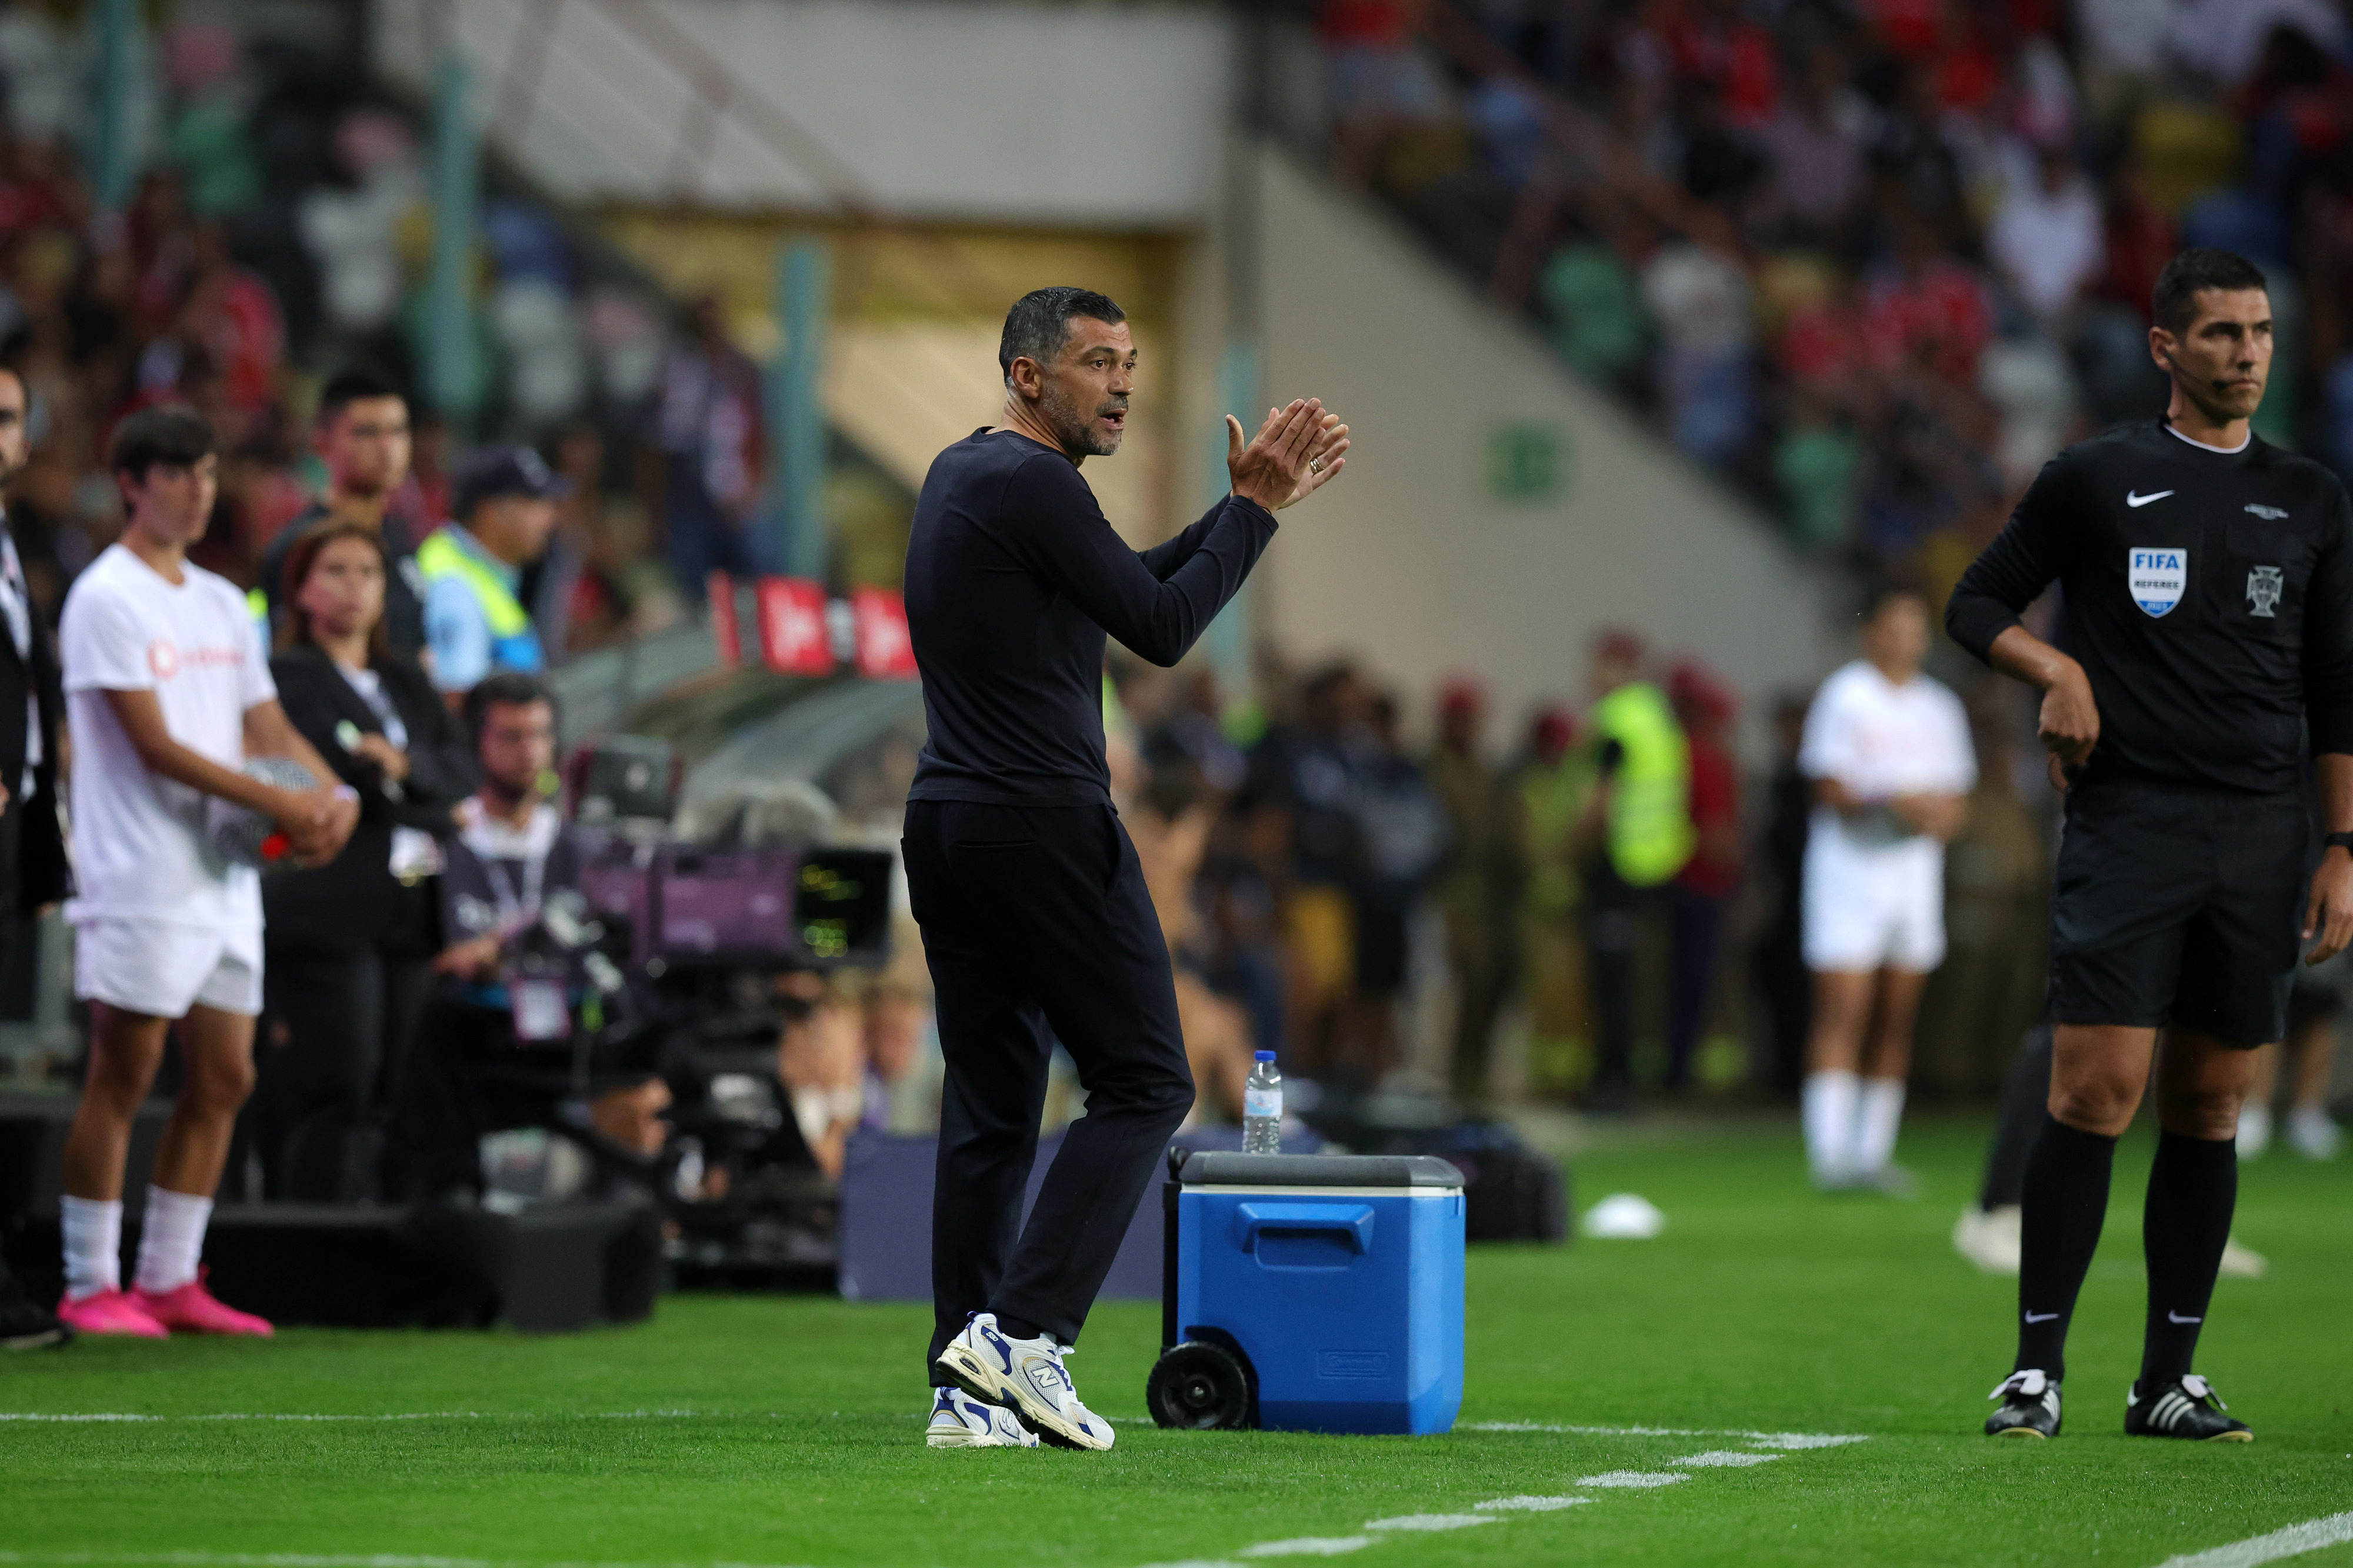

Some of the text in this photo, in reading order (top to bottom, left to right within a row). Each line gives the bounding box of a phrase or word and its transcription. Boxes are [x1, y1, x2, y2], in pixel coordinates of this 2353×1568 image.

[2135, 553, 2179, 569] FIFA
[2134, 580, 2179, 589] REFEREE
[1030, 1366, 1059, 1388] N
